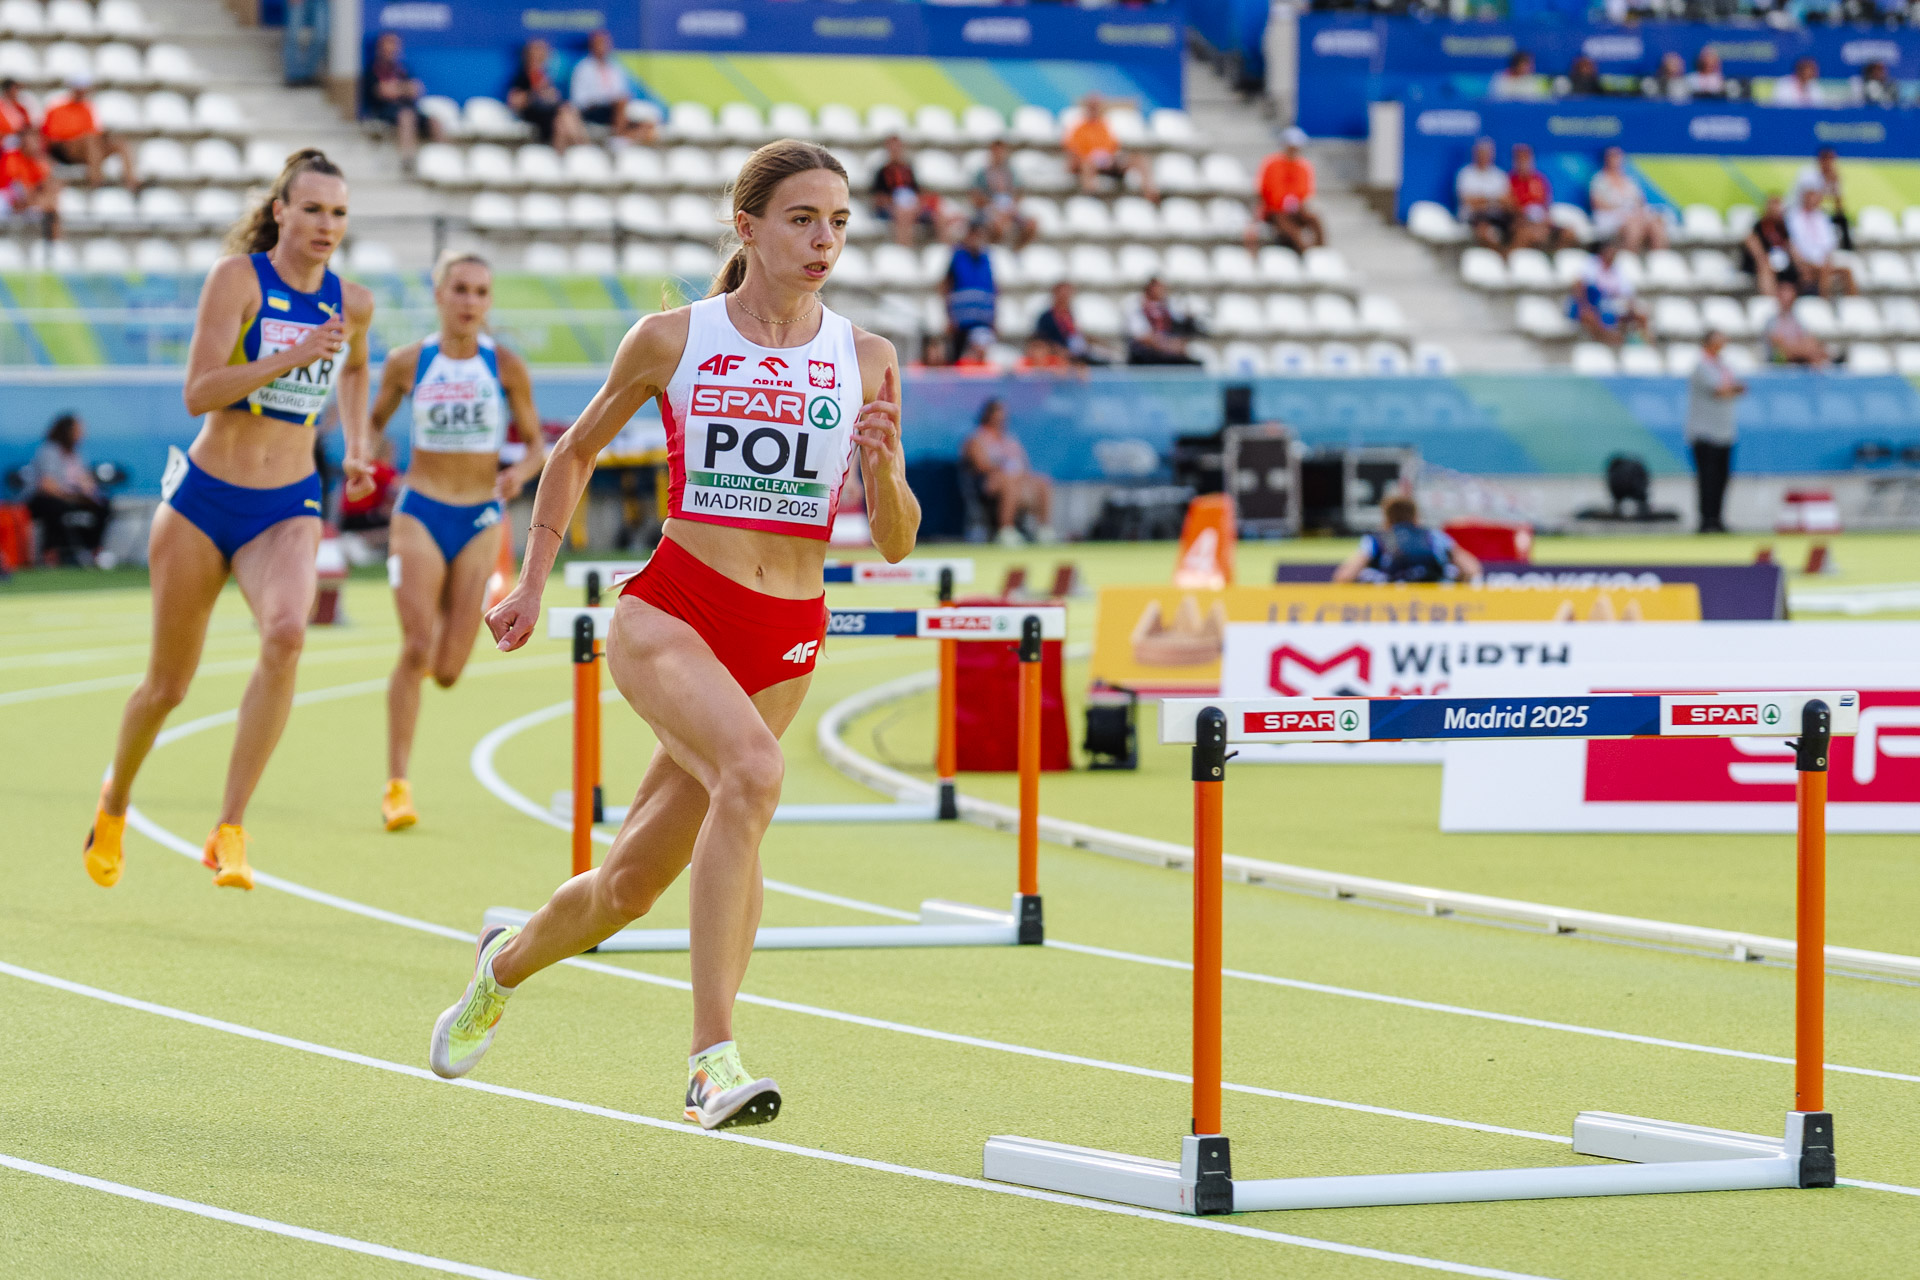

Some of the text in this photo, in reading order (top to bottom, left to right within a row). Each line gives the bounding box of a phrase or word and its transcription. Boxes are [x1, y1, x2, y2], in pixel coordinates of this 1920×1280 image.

[698, 353, 746, 376] 4F
[257, 390, 305, 408] MADRID
[694, 388, 802, 421] SPAR
[428, 403, 485, 425] GRE
[704, 423, 818, 480] POL
[713, 474, 718, 486] I
[720, 475, 751, 489] RUN
[694, 491, 818, 518] MADRID 2025
[939, 617, 991, 631] SPAR
[782, 639, 818, 664] 4F
[1264, 713, 1334, 730] SPAR
[1443, 705, 1590, 729] Madrid 2025
[1690, 707, 1758, 722] SPAR
